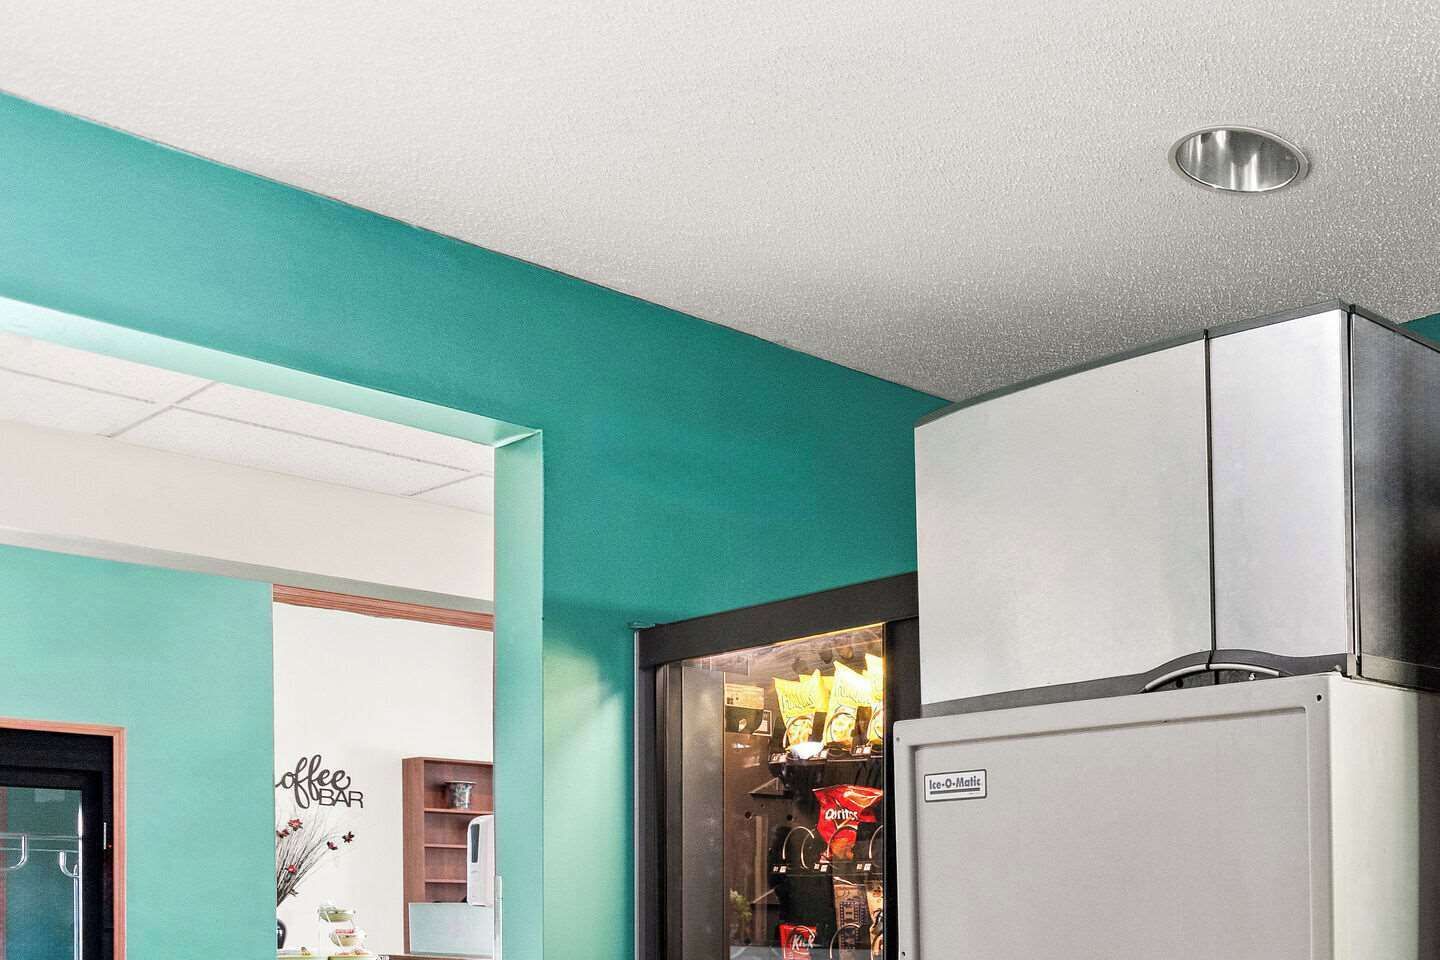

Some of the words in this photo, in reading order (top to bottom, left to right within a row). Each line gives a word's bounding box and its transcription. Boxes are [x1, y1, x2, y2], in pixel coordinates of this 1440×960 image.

[275, 754, 351, 809] offee
[929, 775, 981, 790] Ice-O-Matic
[319, 788, 363, 809] BAR
